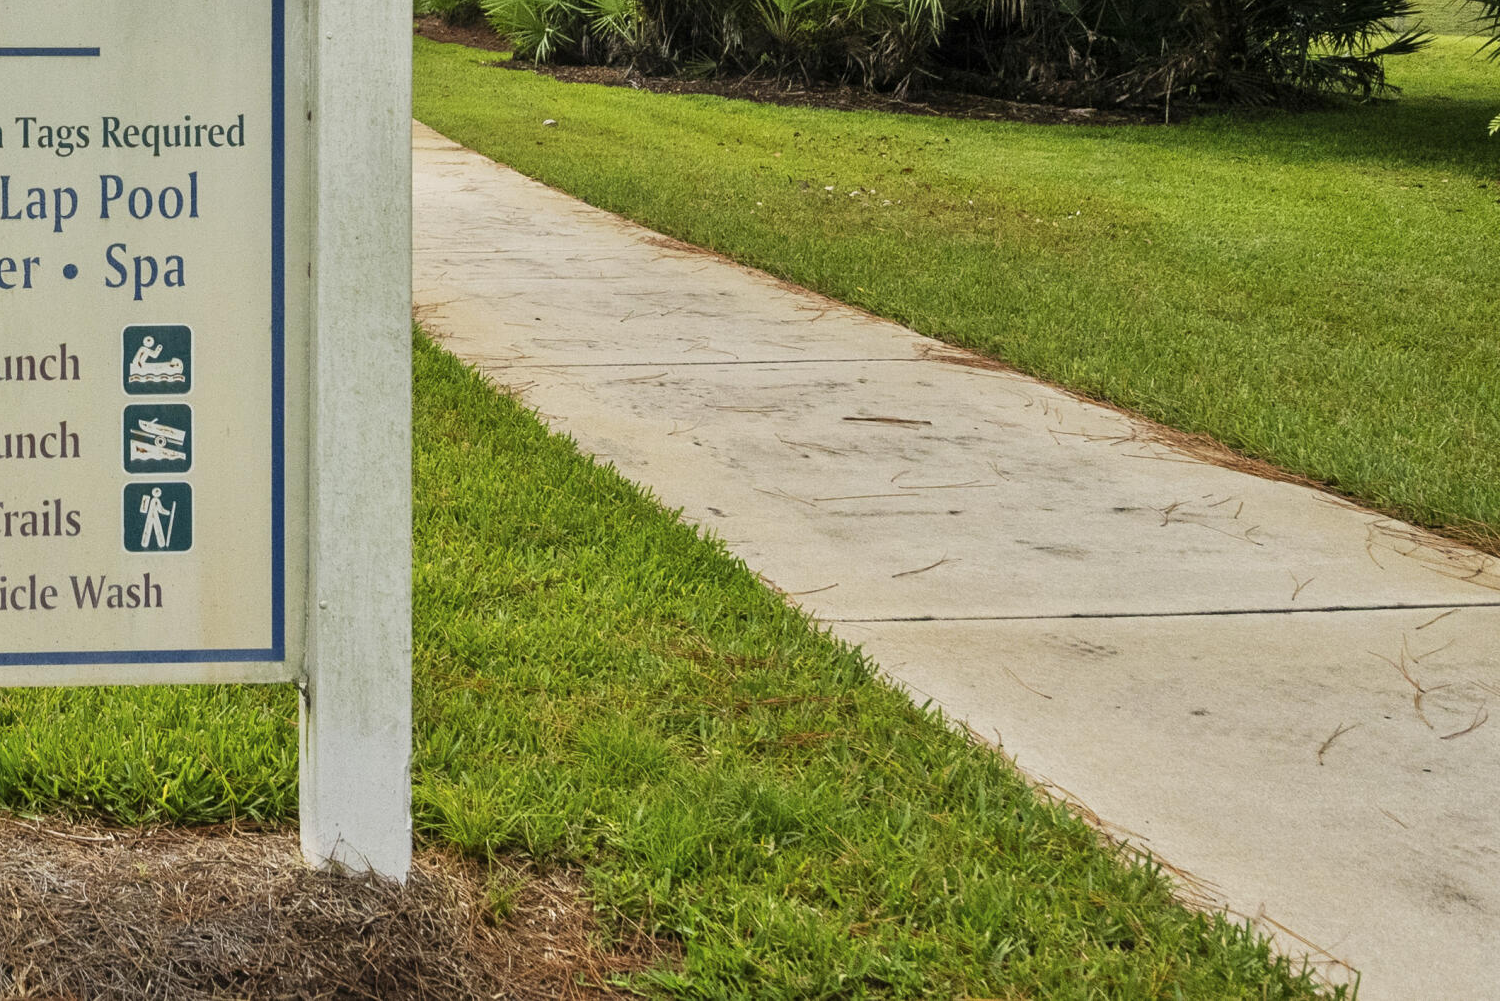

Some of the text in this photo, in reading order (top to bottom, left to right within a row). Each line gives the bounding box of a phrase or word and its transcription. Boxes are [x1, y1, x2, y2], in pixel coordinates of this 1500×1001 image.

[14, 116, 90, 158] Tags
[101, 113, 245, 158] Required
[0, 175, 79, 234] Lap
[99, 170, 200, 220] Pool
[104, 242, 186, 302] Spa
[69, 572, 163, 610] Wash
